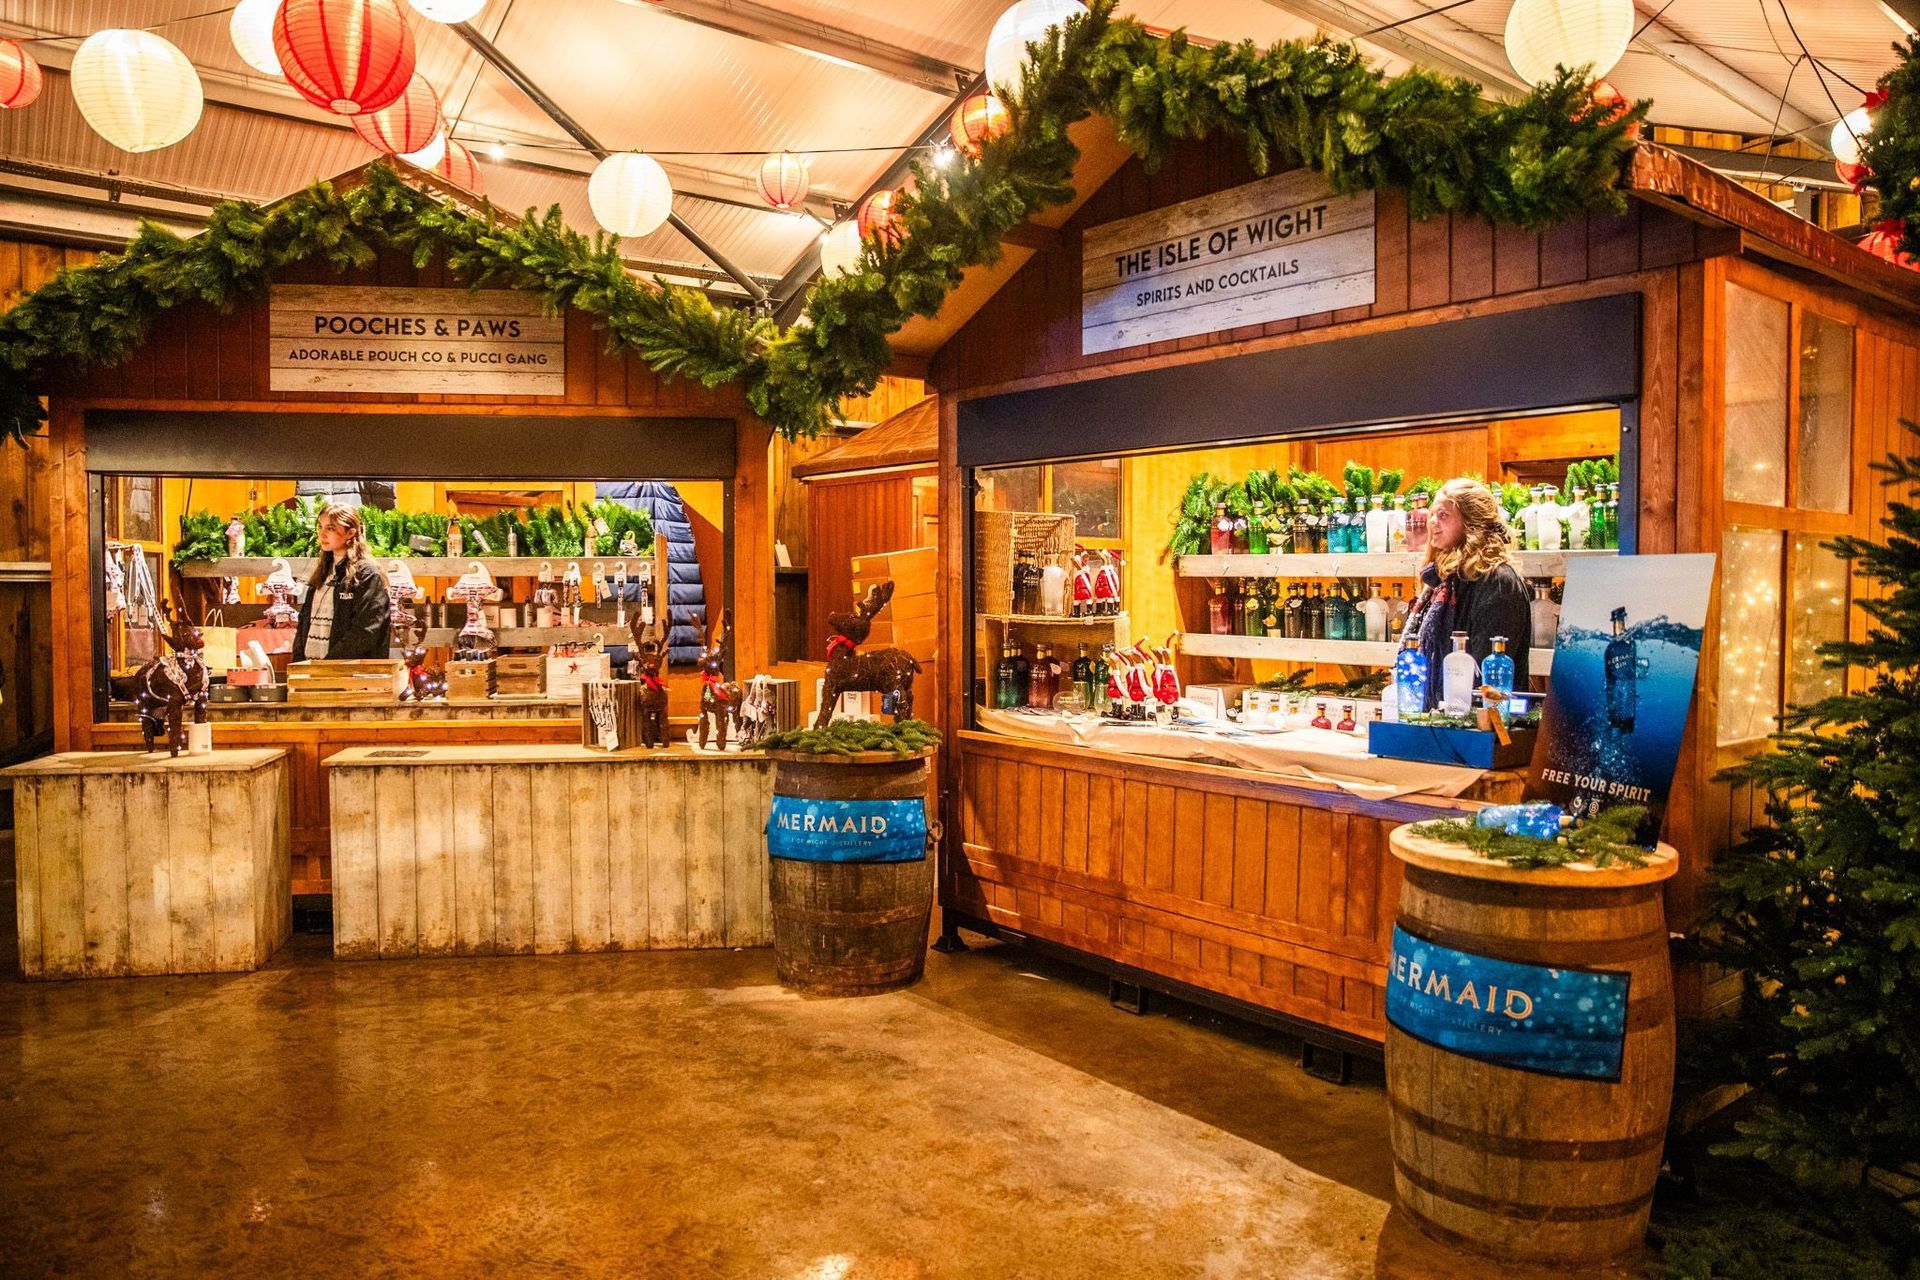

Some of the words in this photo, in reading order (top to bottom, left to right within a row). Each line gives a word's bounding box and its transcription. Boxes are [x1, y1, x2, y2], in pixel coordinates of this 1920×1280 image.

[1116, 249, 1152, 277] THE
[1159, 237, 1201, 268] ISLE
[1208, 226, 1239, 255] OF
[1246, 205, 1328, 245] WIGHT
[1136, 286, 1182, 307] SPIRITS
[1186, 278, 1215, 297] AND
[1218, 259, 1300, 288] COCKTAILS
[315, 316, 426, 336] POOCHES
[434, 319, 450, 336] &
[458, 319, 521, 338] PAWS
[289, 349, 364, 362] ADORABLE
[368, 350, 417, 363] POUCH
[422, 352, 442, 363] CO
[447, 352, 457, 363] &
[461, 352, 501, 364] PUCCI
[505, 353, 547, 365] GANG
[1541, 768, 1571, 785] FREE
[1574, 774, 1607, 792] YOUR
[1608, 782, 1652, 802] SPIRIT
[777, 812, 887, 834] MERMAID
